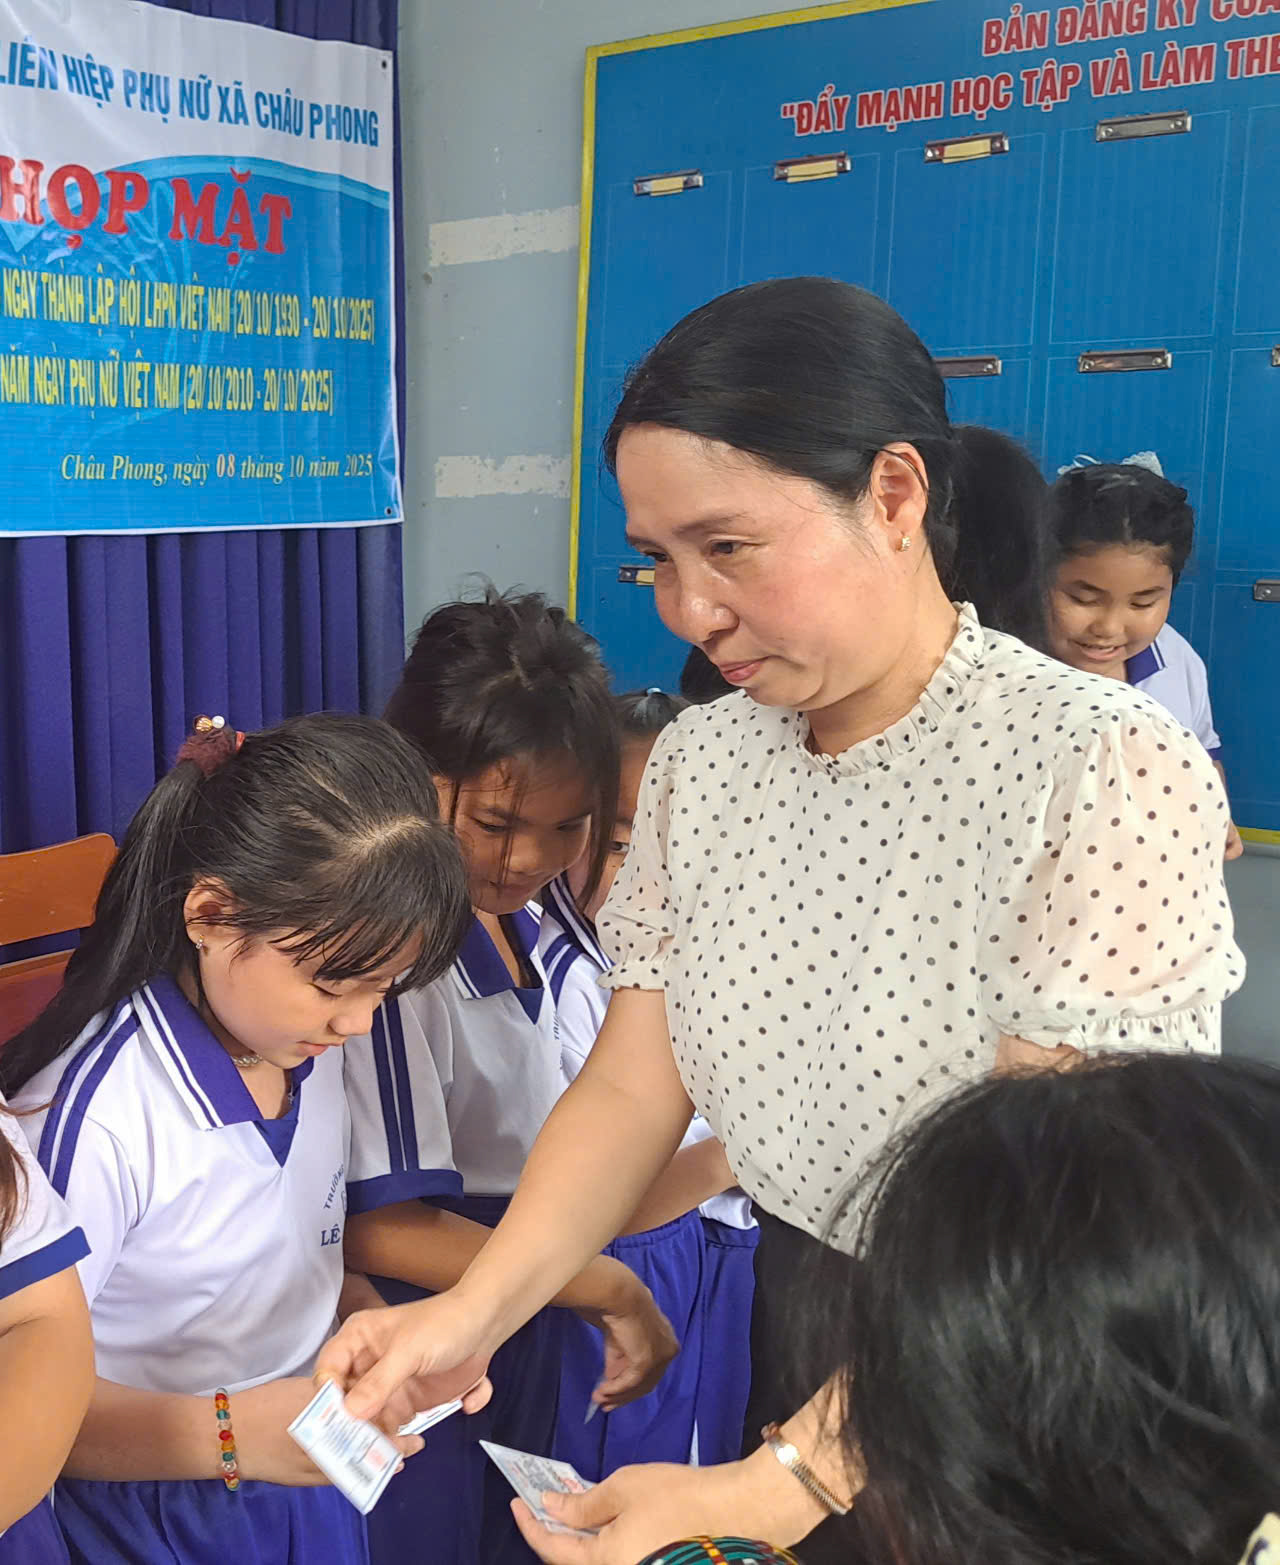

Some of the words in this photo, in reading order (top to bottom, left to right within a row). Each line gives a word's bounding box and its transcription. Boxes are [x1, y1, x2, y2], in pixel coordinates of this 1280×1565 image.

[982, 4, 1050, 56] BẢN
[62, 53, 115, 109] HIỆP
[123, 68, 170, 124] PHỤ
[178, 73, 212, 121] NỮ
[218, 80, 250, 127] XÃ
[255, 88, 304, 137] CHÂU
[309, 102, 379, 147] PHONG
[856, 81, 945, 131] MẠNH
[951, 73, 1013, 121] HỌC
[1022, 59, 1081, 111] TẬP
[1090, 48, 1132, 97] VÀ
[1140, 41, 1217, 91] LÀM
[169, 166, 292, 266] MẶT
[4, 255, 37, 320] NGÀY
[41, 258, 85, 324] THÀNH
[0, 344, 31, 405] NĂM
[34, 341, 66, 406] NGÀY
[155, 362, 180, 409] NAM
[61, 453, 106, 481] Châu
[111, 454, 168, 488] Phong,
[172, 454, 211, 487] ngày
[216, 453, 236, 479] 08
[241, 454, 285, 486] tháng
[289, 455, 305, 478] 10
[308, 456, 341, 478] năm
[344, 453, 374, 477] 2025
